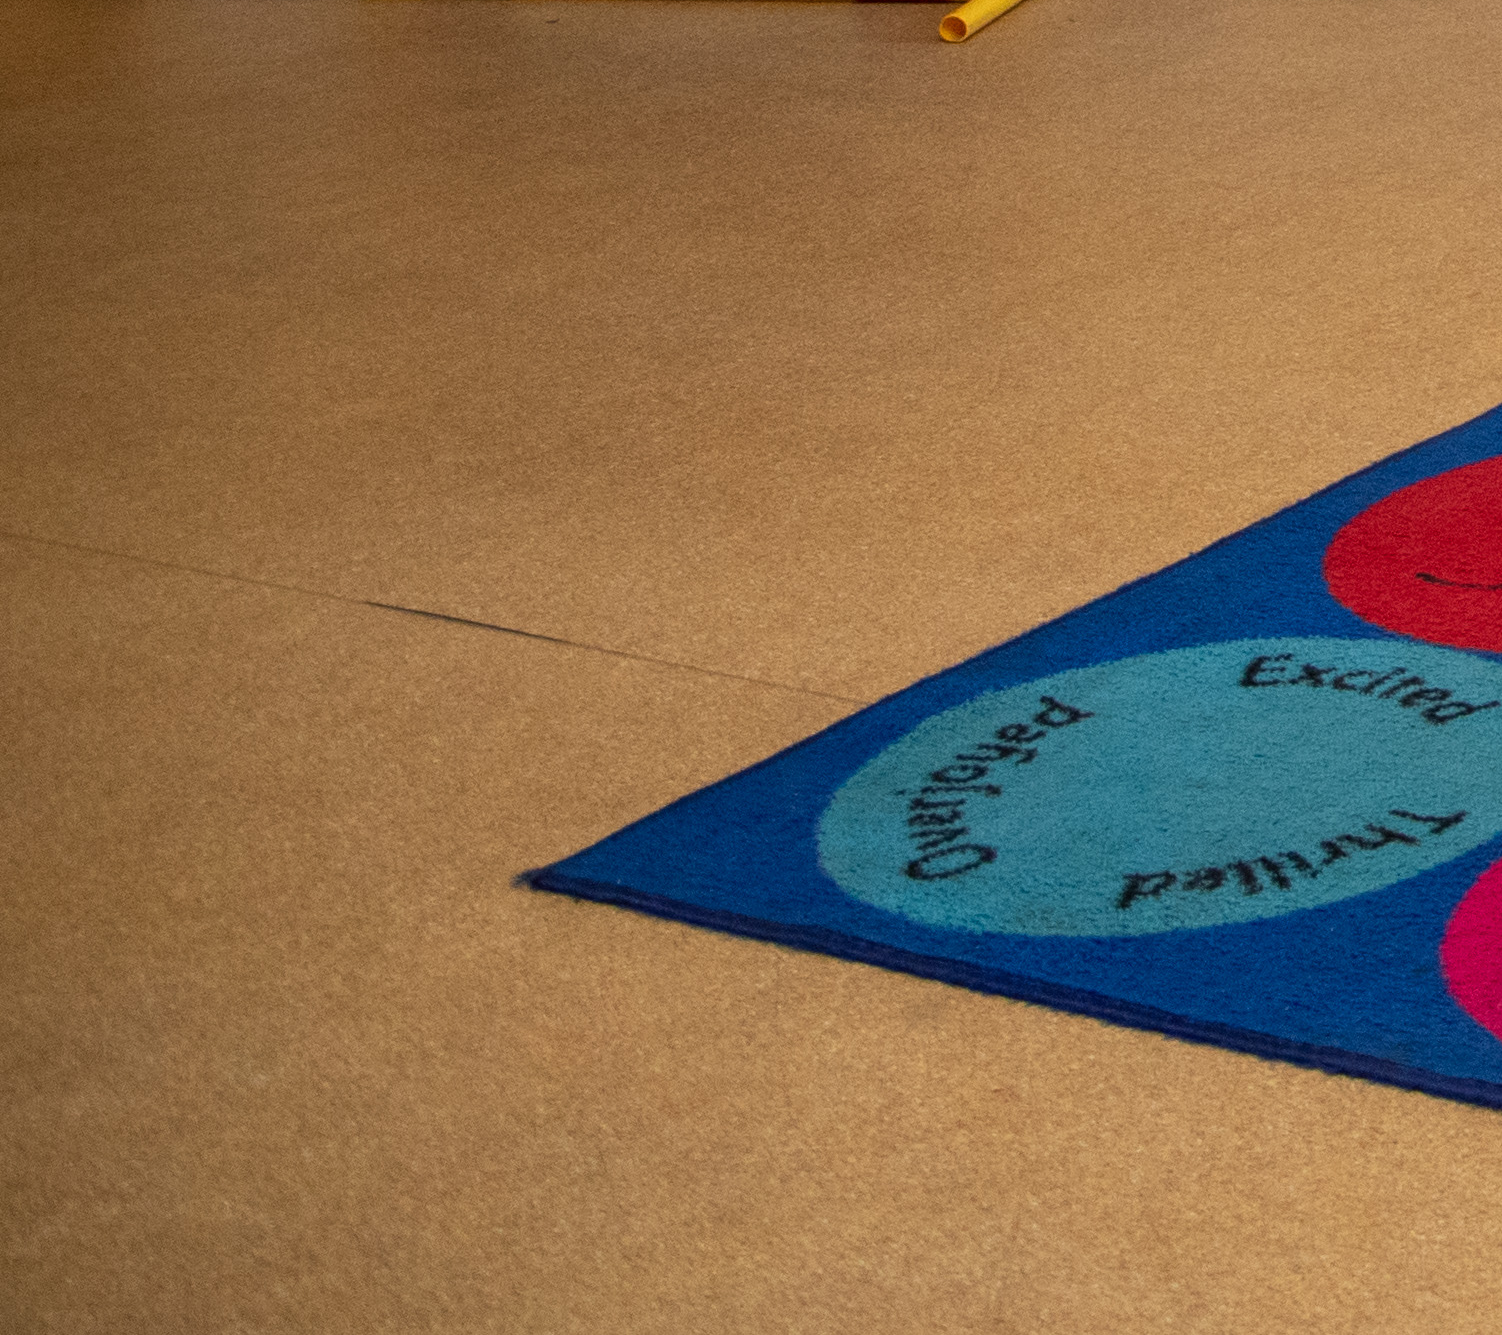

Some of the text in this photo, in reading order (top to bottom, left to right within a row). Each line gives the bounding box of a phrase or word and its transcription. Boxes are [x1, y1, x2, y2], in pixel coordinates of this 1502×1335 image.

[1240, 653, 1500, 725] Excited
[900, 696, 1095, 882] Overjoyed
[1116, 809, 1470, 910] Thrilled
